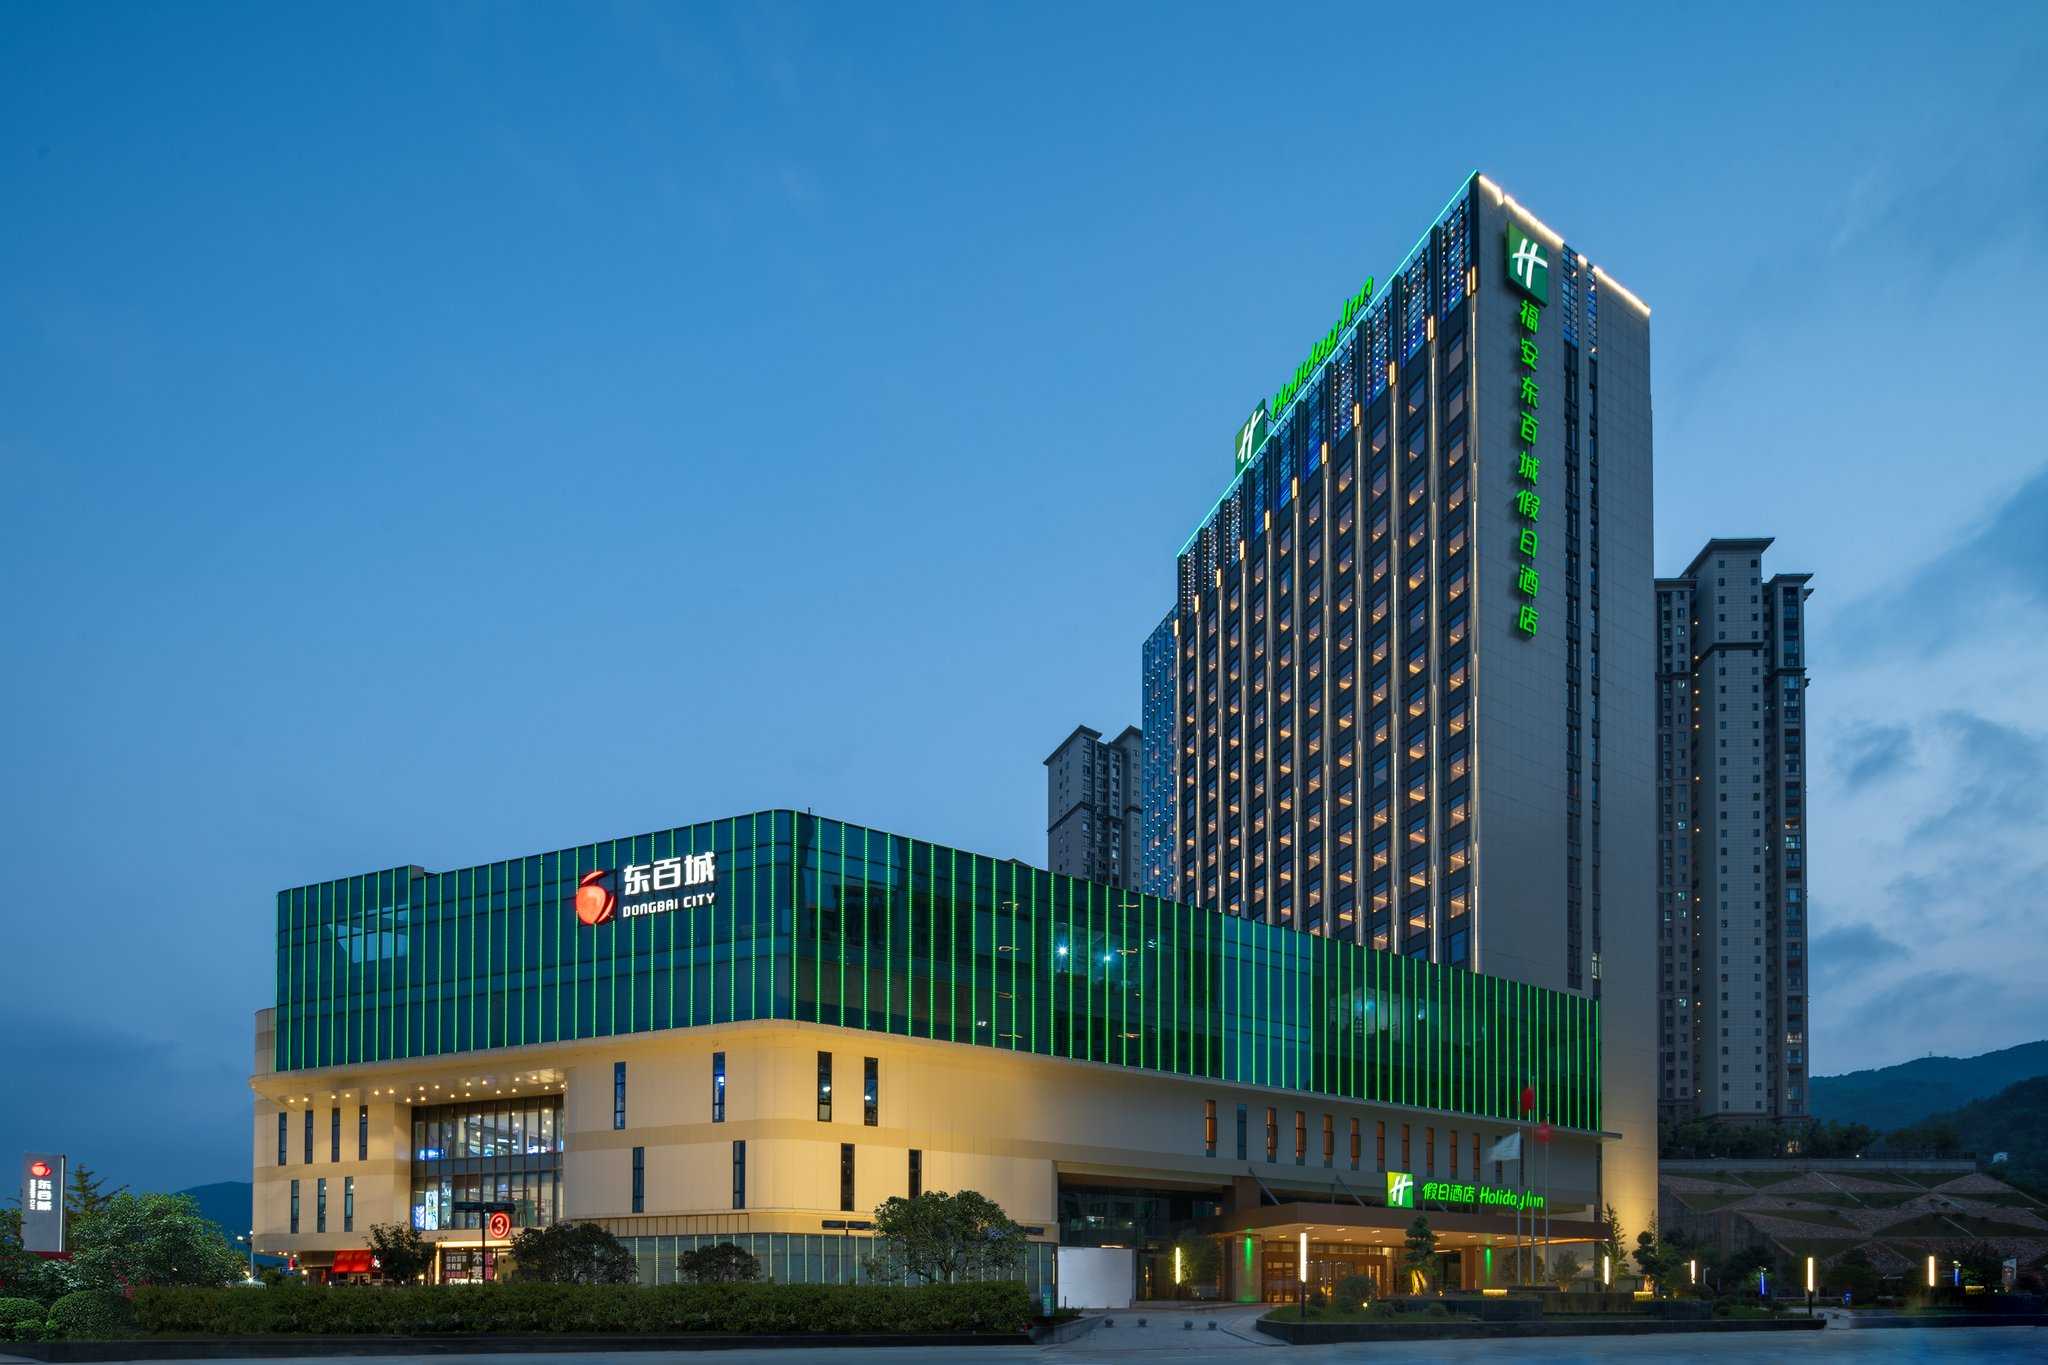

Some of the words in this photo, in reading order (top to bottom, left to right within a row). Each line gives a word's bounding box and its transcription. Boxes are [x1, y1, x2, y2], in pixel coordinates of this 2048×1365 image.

[1341, 276, 1374, 330] Inn
[1516, 300, 1541, 635] 福安东百城假日酒店
[623, 851, 716, 896] 东百城
[622, 897, 679, 918] DONGBAI
[683, 892, 715, 909] CITY
[1422, 1182, 1476, 1203] 假日酒店
[1480, 1186, 1525, 1210] Holiday
[1526, 1190, 1544, 1208] Inn
